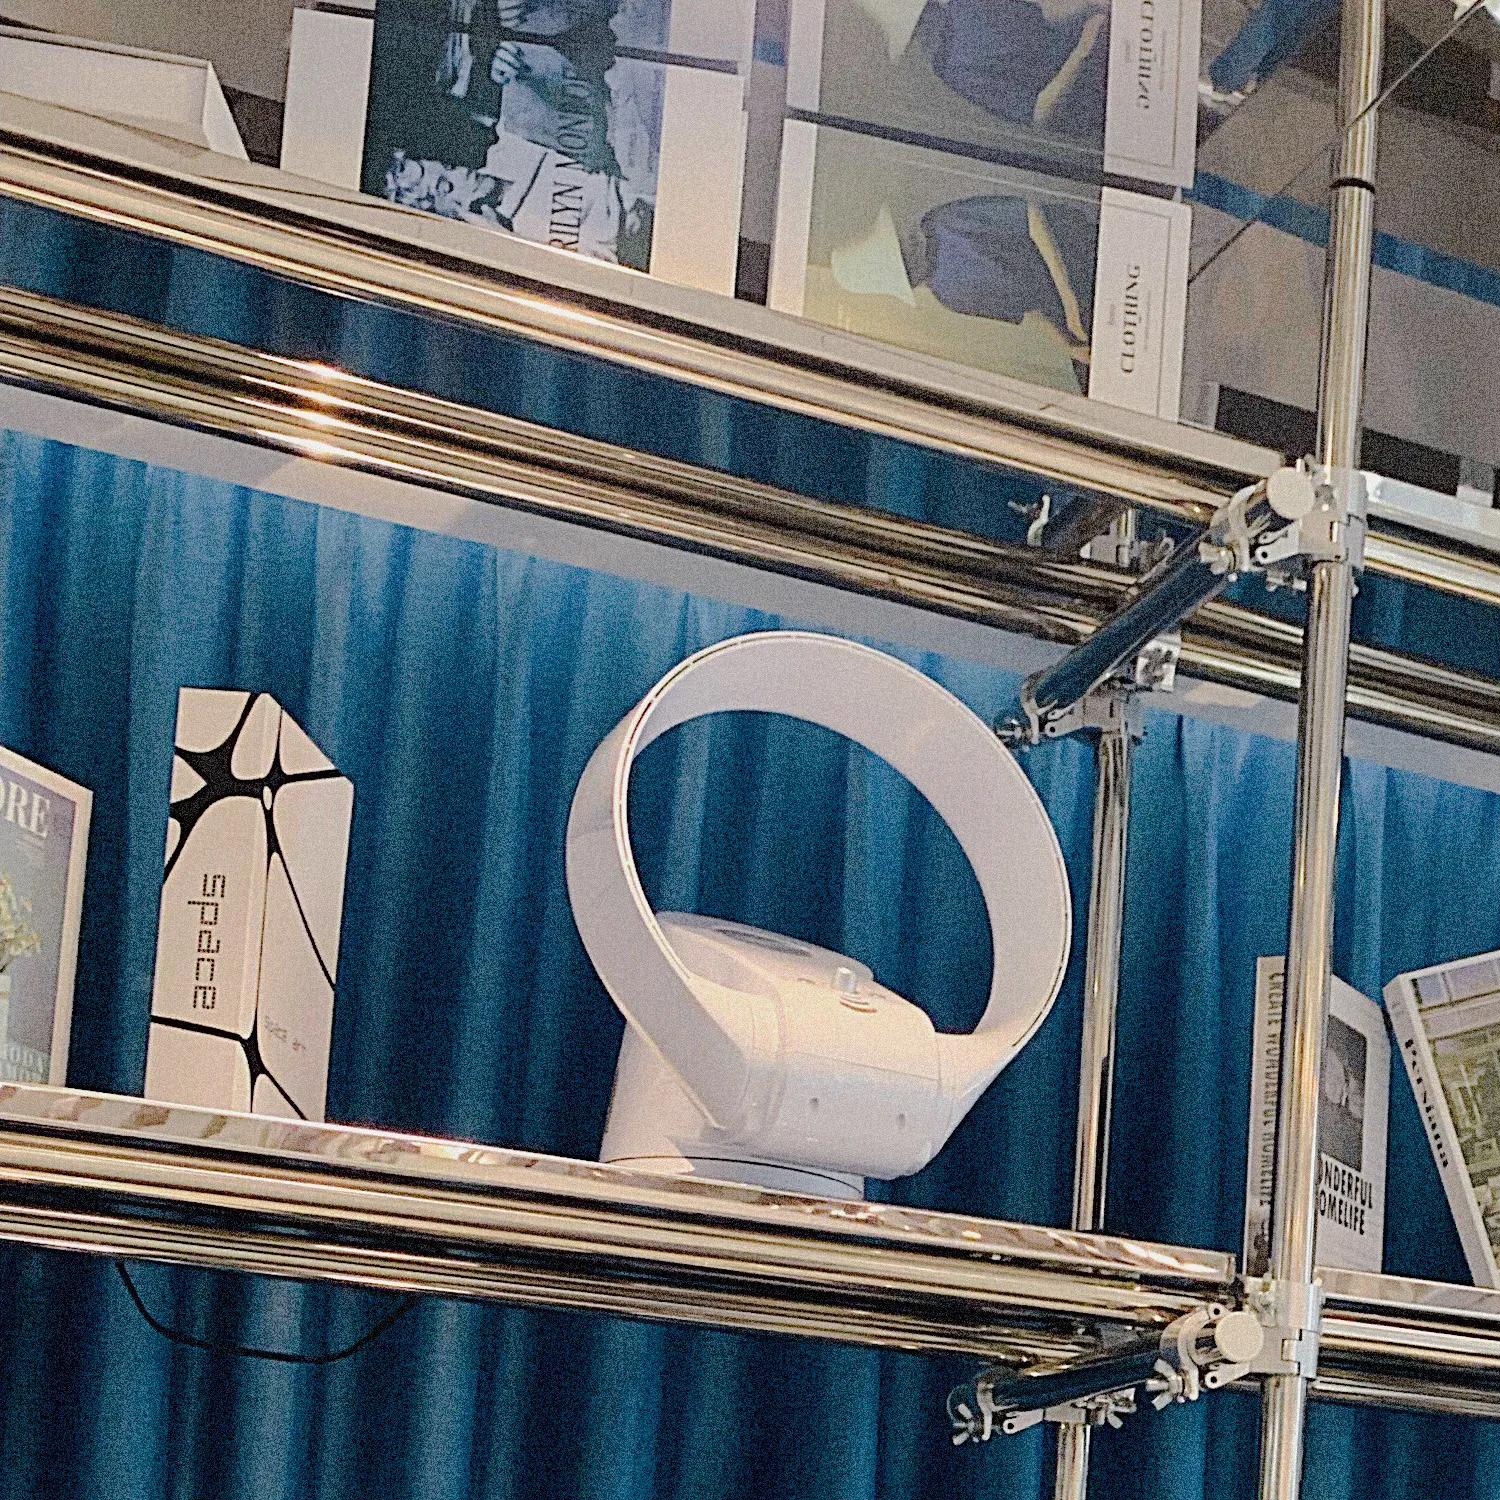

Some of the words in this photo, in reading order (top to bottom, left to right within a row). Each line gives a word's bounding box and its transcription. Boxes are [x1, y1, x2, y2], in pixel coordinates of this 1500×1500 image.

[548, 182, 583, 252] RILYN
[1120, 264, 1141, 374] CLOTHING
[0, 776, 51, 838] RE
[187, 872, 226, 1010] space
[1318, 1160, 1373, 1209] NDERFUL
[1319, 1189, 1365, 1235] OMELIFE
